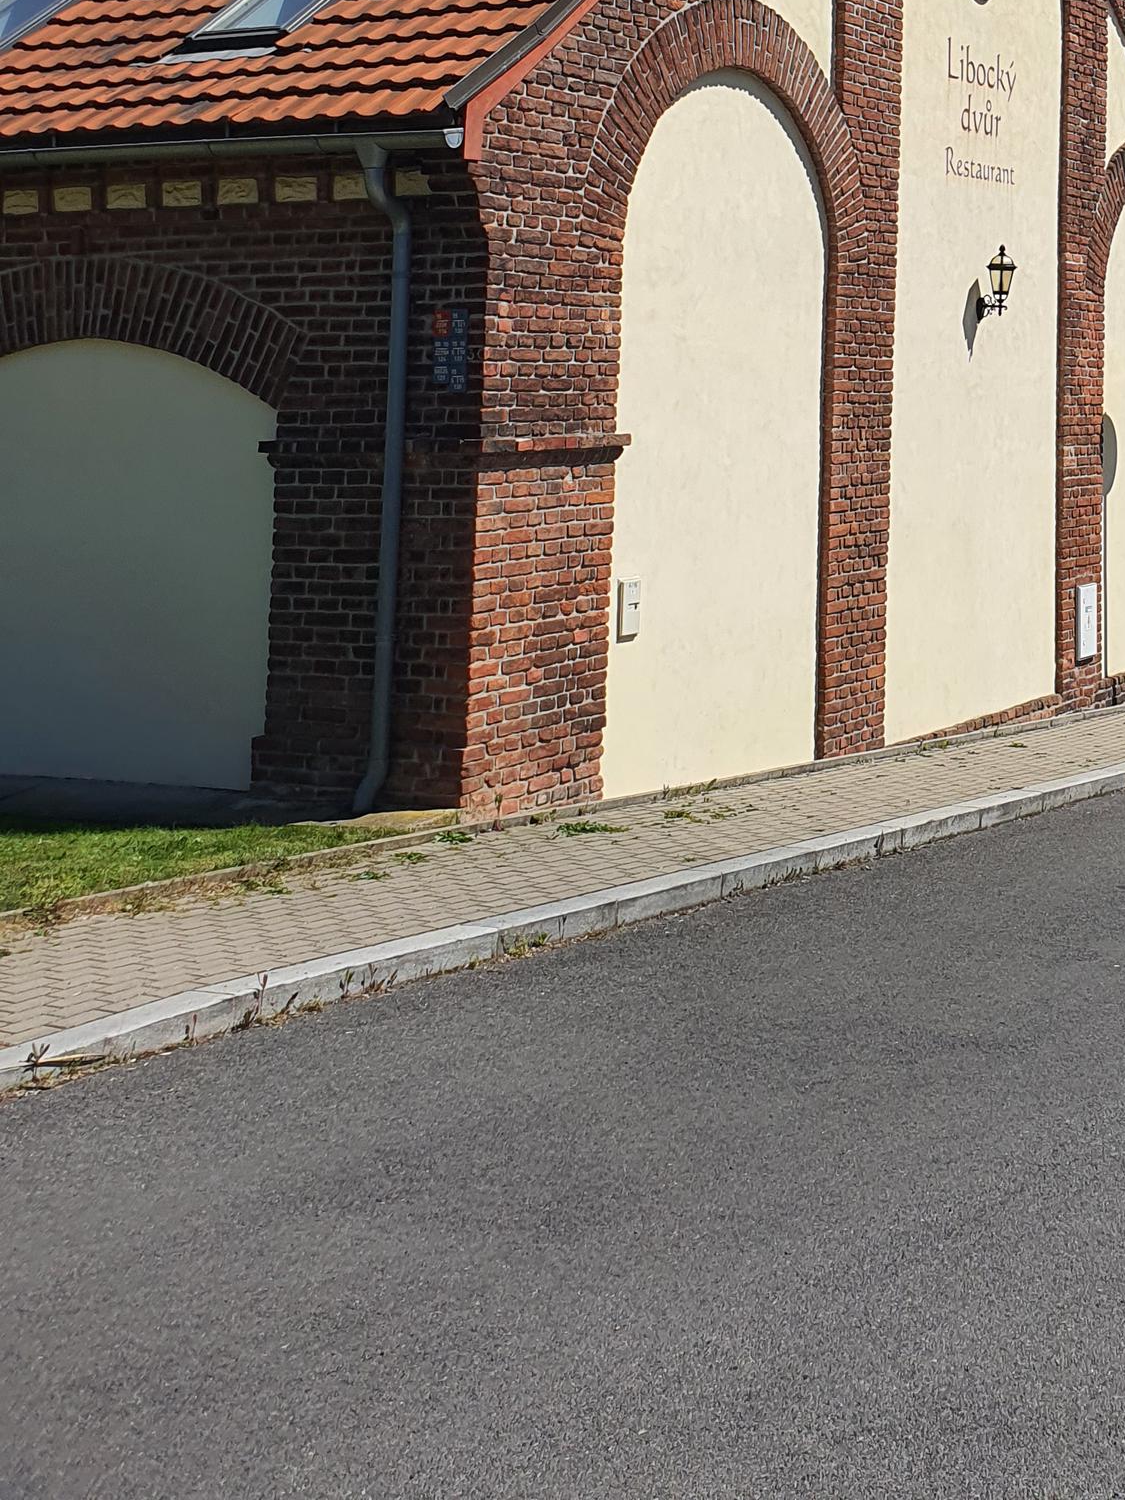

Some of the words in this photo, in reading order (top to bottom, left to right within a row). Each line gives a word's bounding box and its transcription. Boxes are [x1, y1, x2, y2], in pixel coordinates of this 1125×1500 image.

[947, 36, 1016, 102] Libocký
[961, 94, 1001, 138] dvůr
[945, 146, 1015, 185] Restaurant
